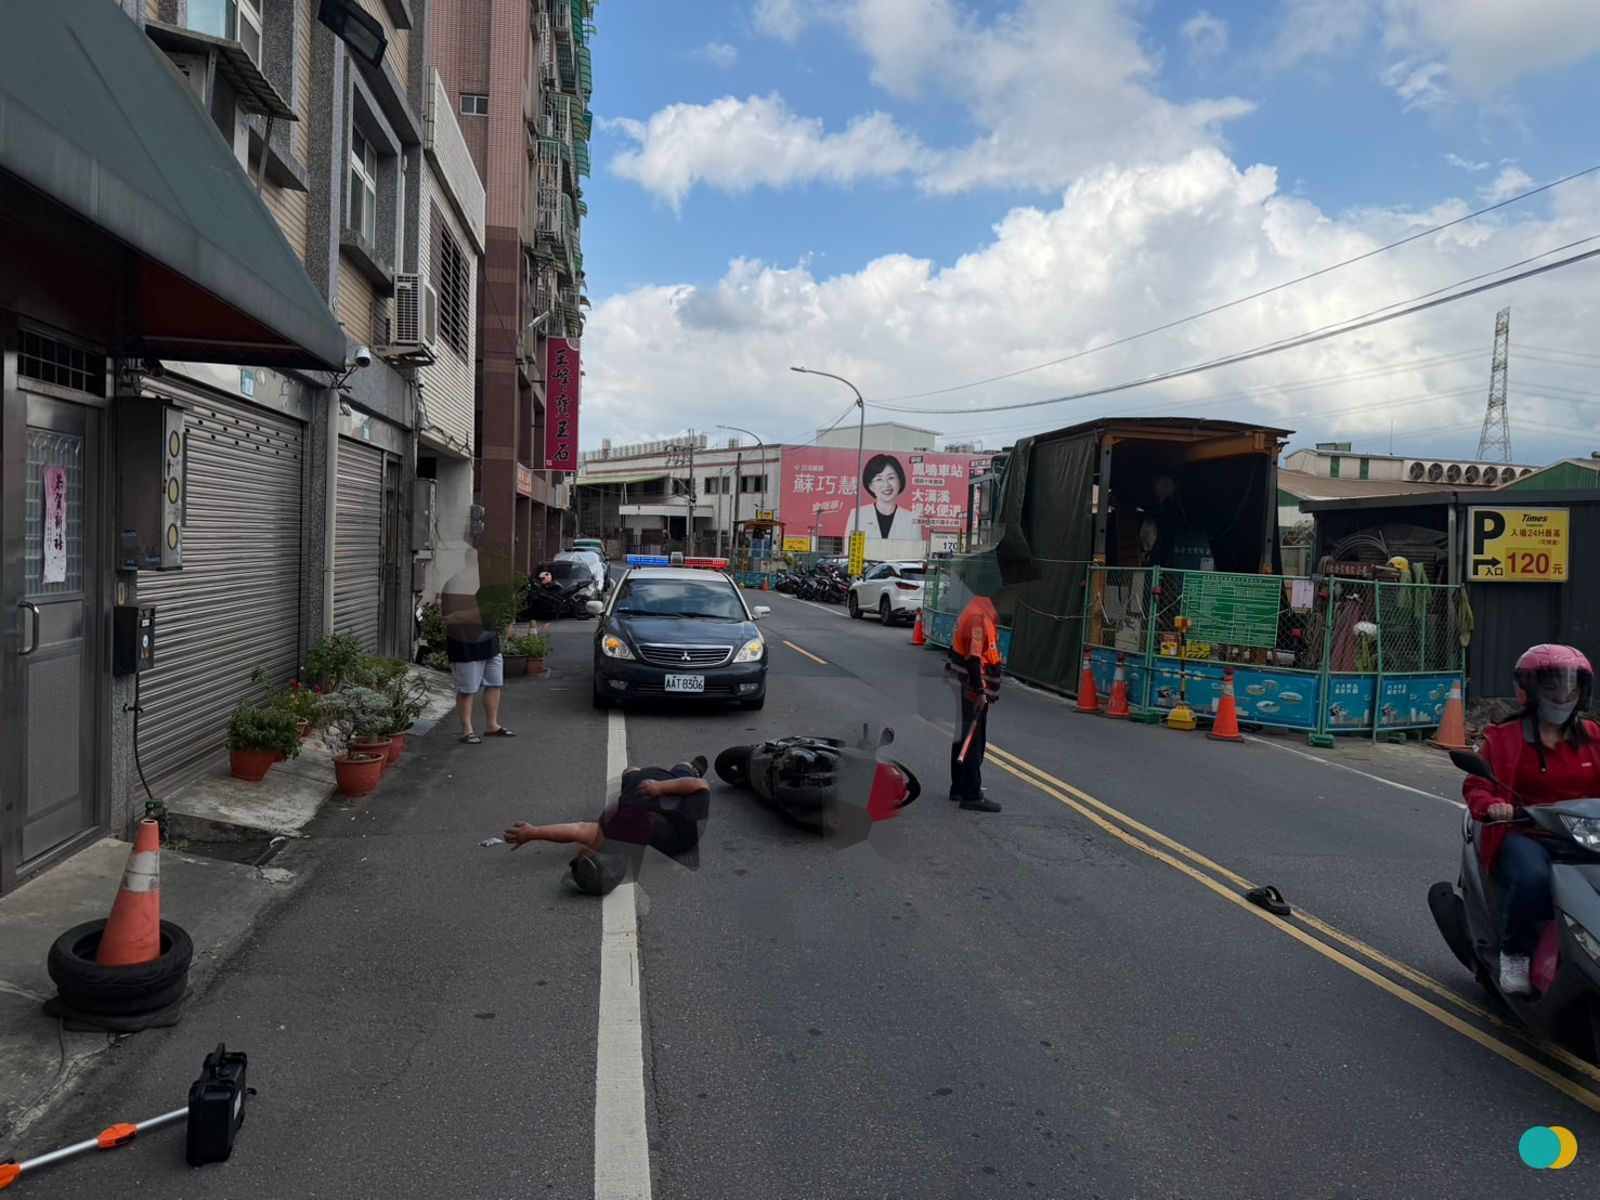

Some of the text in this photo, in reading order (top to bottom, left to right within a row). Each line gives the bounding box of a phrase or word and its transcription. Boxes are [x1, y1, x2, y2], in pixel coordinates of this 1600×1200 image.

[792, 474, 858, 496] 蘇巧慧
[912, 489, 950, 503] 大漢溪
[1521, 513, 1549, 522] Times
[1474, 511, 1506, 555] P
[1510, 528, 1561, 537] 入場24H最高
[1507, 551, 1564, 575] 120 元
[1485, 567, 1503, 576] 入口
